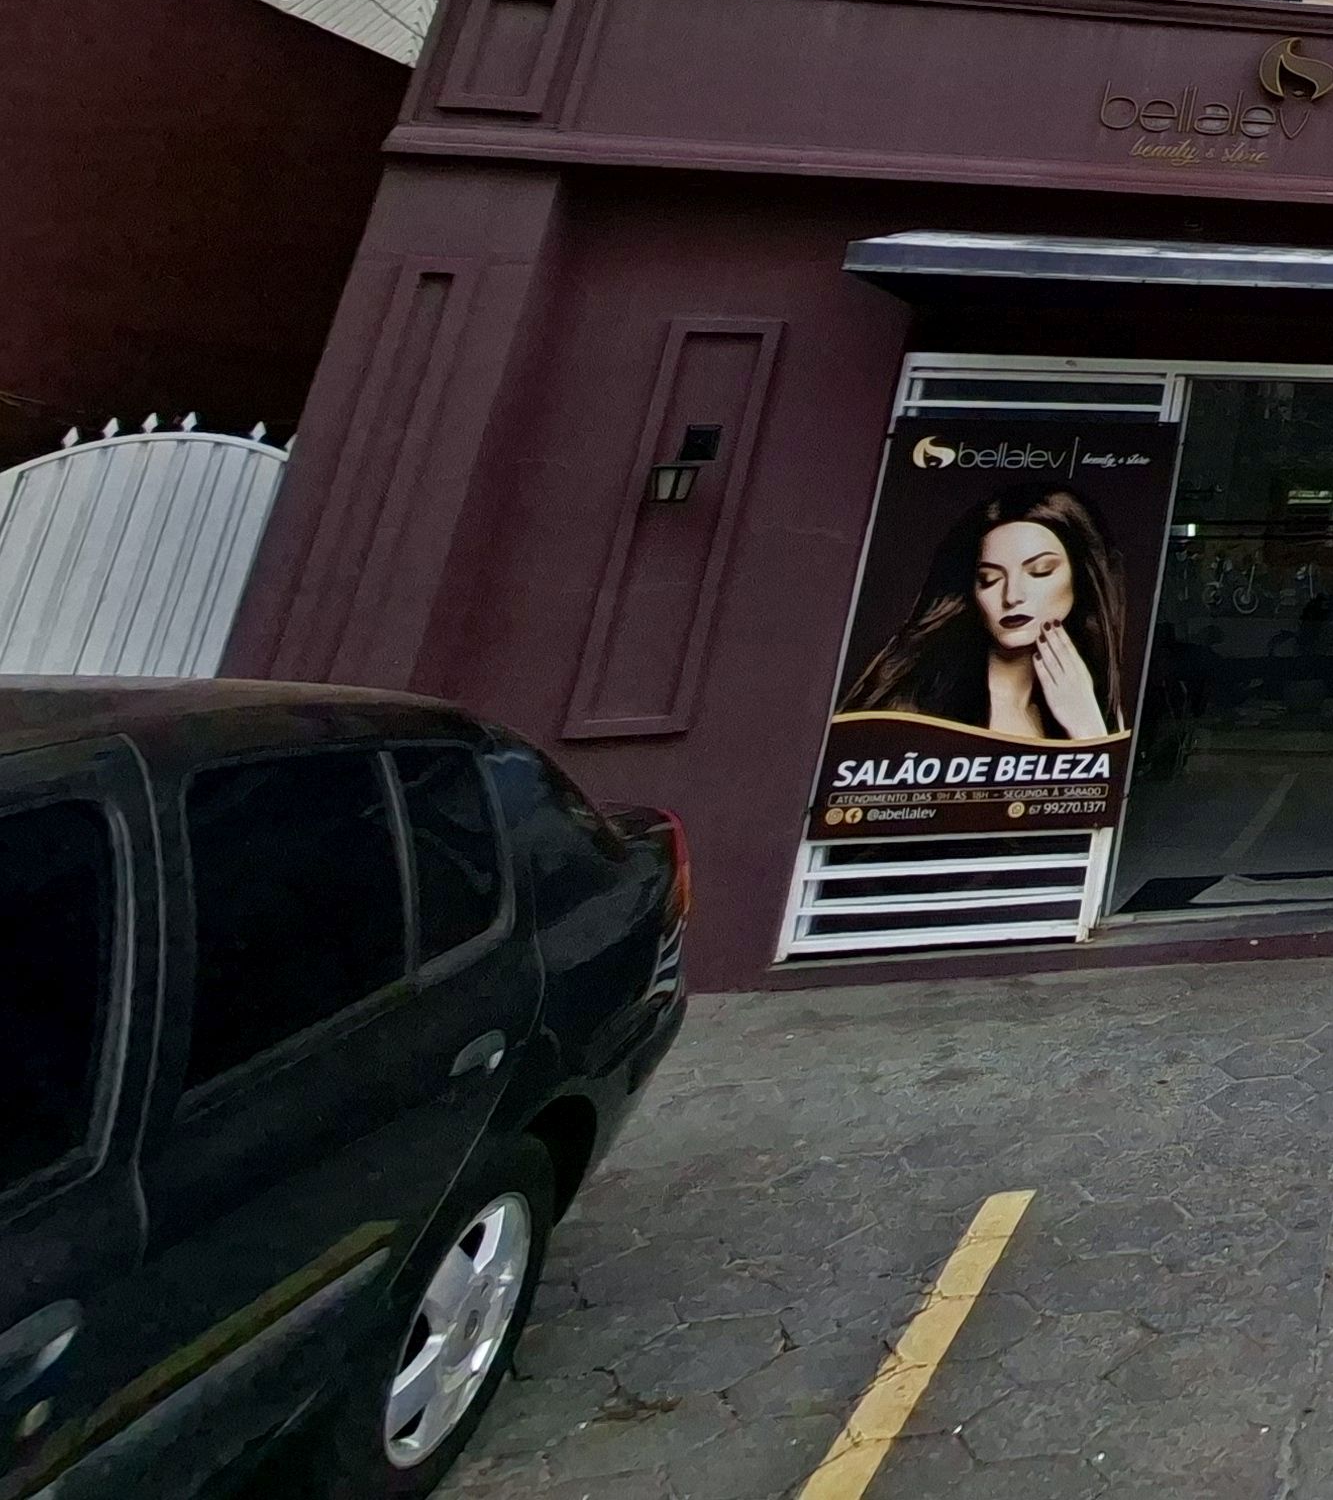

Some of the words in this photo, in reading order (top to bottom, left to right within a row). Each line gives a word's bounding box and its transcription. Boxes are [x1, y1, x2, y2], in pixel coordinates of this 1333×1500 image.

[1100, 80, 1310, 140] bellalev
[957, 442, 1066, 469] bellalev
[832, 752, 941, 787] SALÃO
[944, 756, 992, 783] DE
[994, 753, 1110, 781] BELEZA
[836, 793, 908, 804] ATENDIMENTO
[912, 792, 932, 802] DAS
[1003, 789, 1048, 799] SEGUNDA
[1028, 804, 1042, 815] 67
[1043, 801, 1106, 814] 99270.1371
